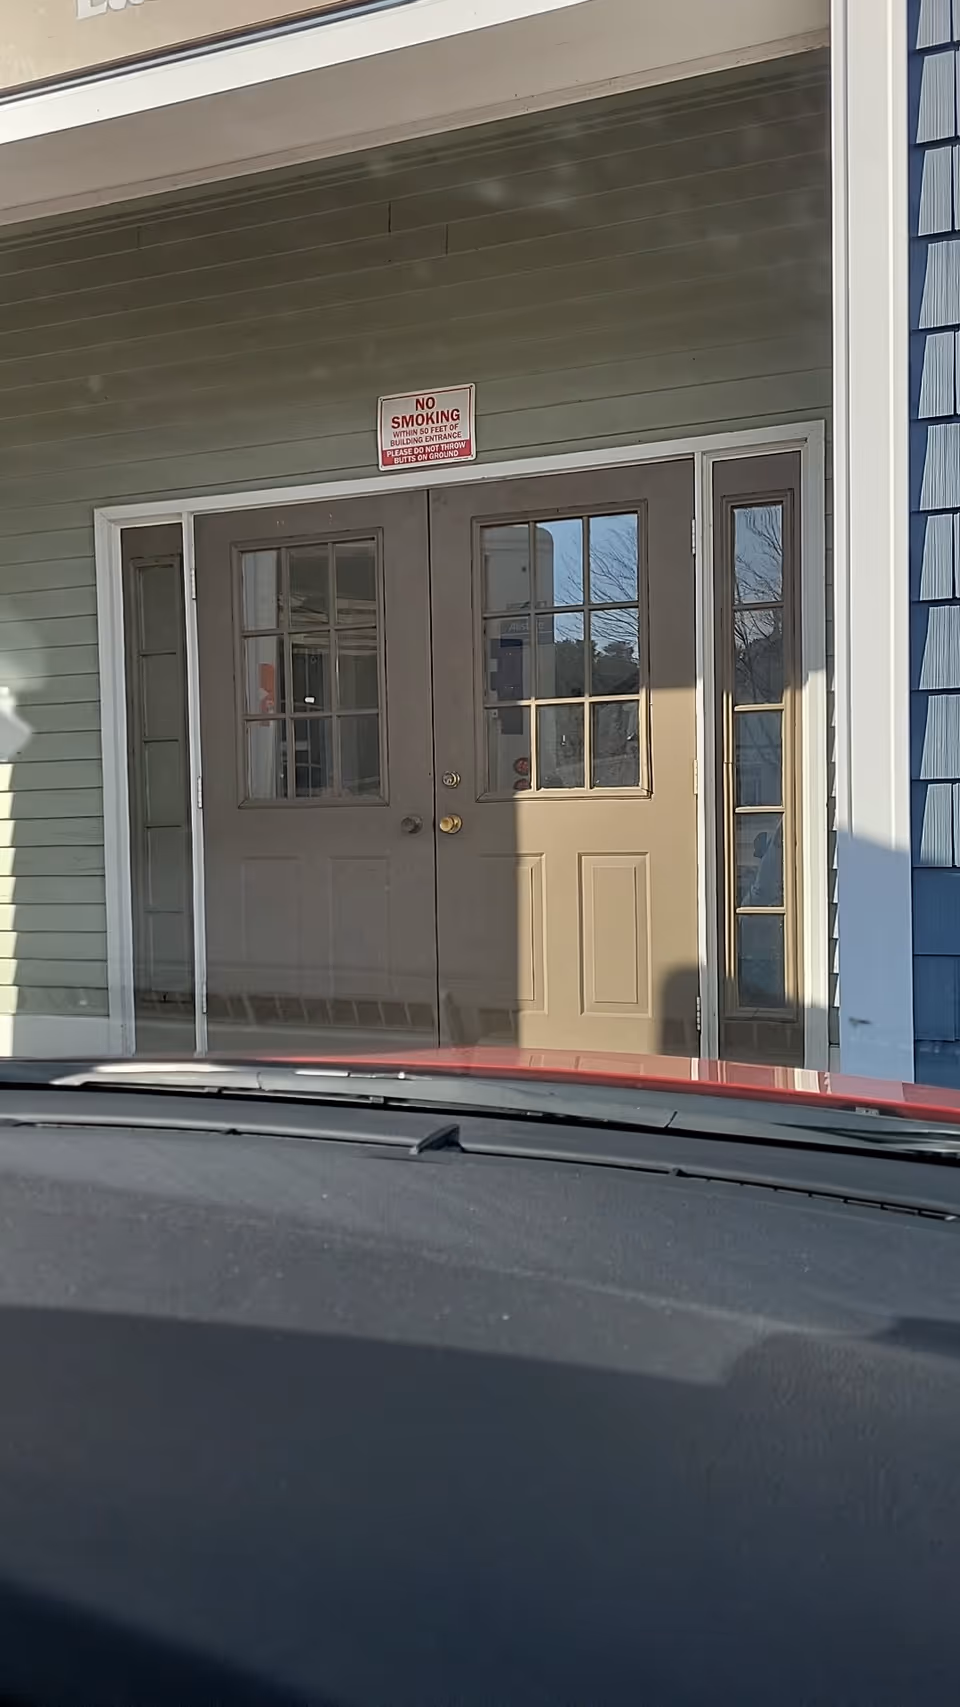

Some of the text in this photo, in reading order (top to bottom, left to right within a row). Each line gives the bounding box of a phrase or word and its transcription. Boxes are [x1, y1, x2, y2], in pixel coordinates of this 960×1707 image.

[415, 396, 436, 411] NO
[391, 408, 460, 429] SMOKING
[392, 423, 459, 438] WITHIN 50 FEET OF
[390, 431, 462, 447] BUILDING ENTRANCE
[387, 441, 466, 458] PLEASE DO NOT THROW
[394, 455, 416, 464] BUTTS
[429, 450, 459, 459] GROUND
